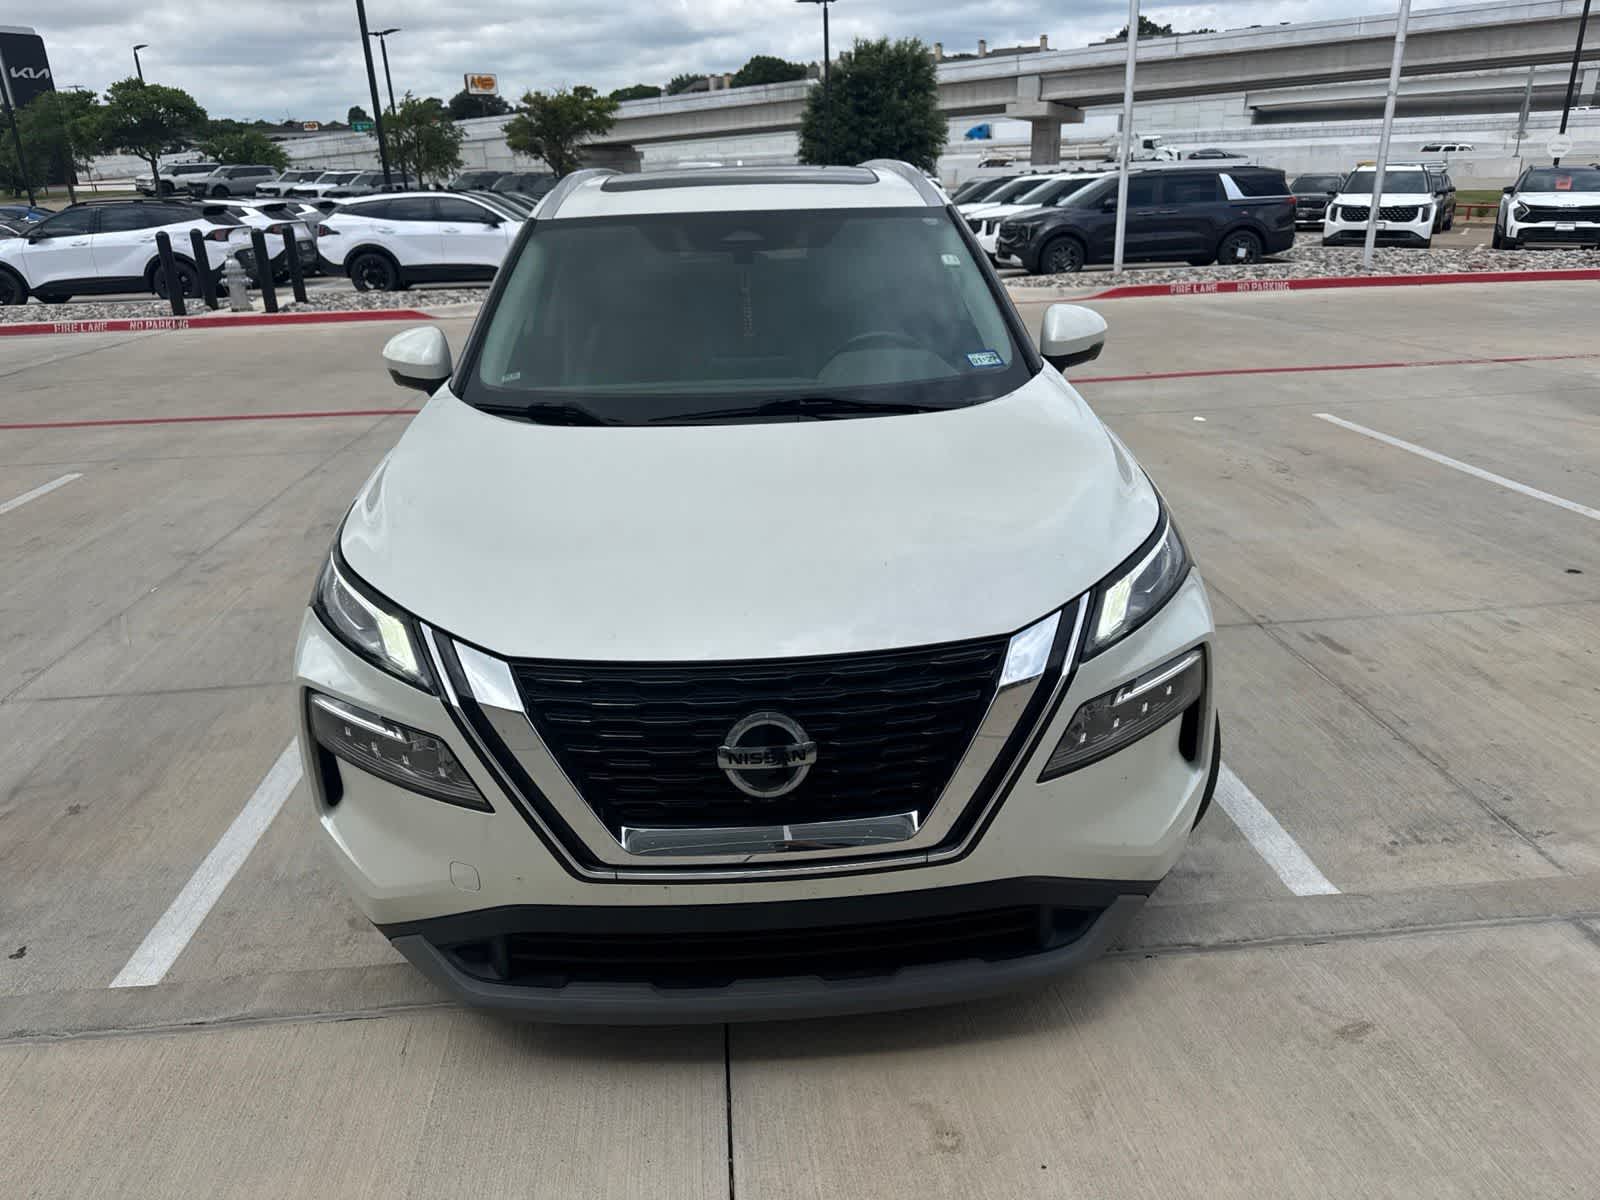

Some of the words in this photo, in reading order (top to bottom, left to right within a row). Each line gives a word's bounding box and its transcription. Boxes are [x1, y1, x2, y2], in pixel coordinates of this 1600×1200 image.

[1169, 283, 1192, 294] FIRE
[1193, 282, 1217, 293] LANE
[1237, 281, 1250, 292] NO
[1251, 280, 1289, 292] PARKING
[54, 322, 78, 333] FIRE
[80, 321, 108, 332] LANE
[129, 320, 143, 330] NO
[145, 318, 189, 330] PARKING
[728, 750, 806, 765] NISSAN
